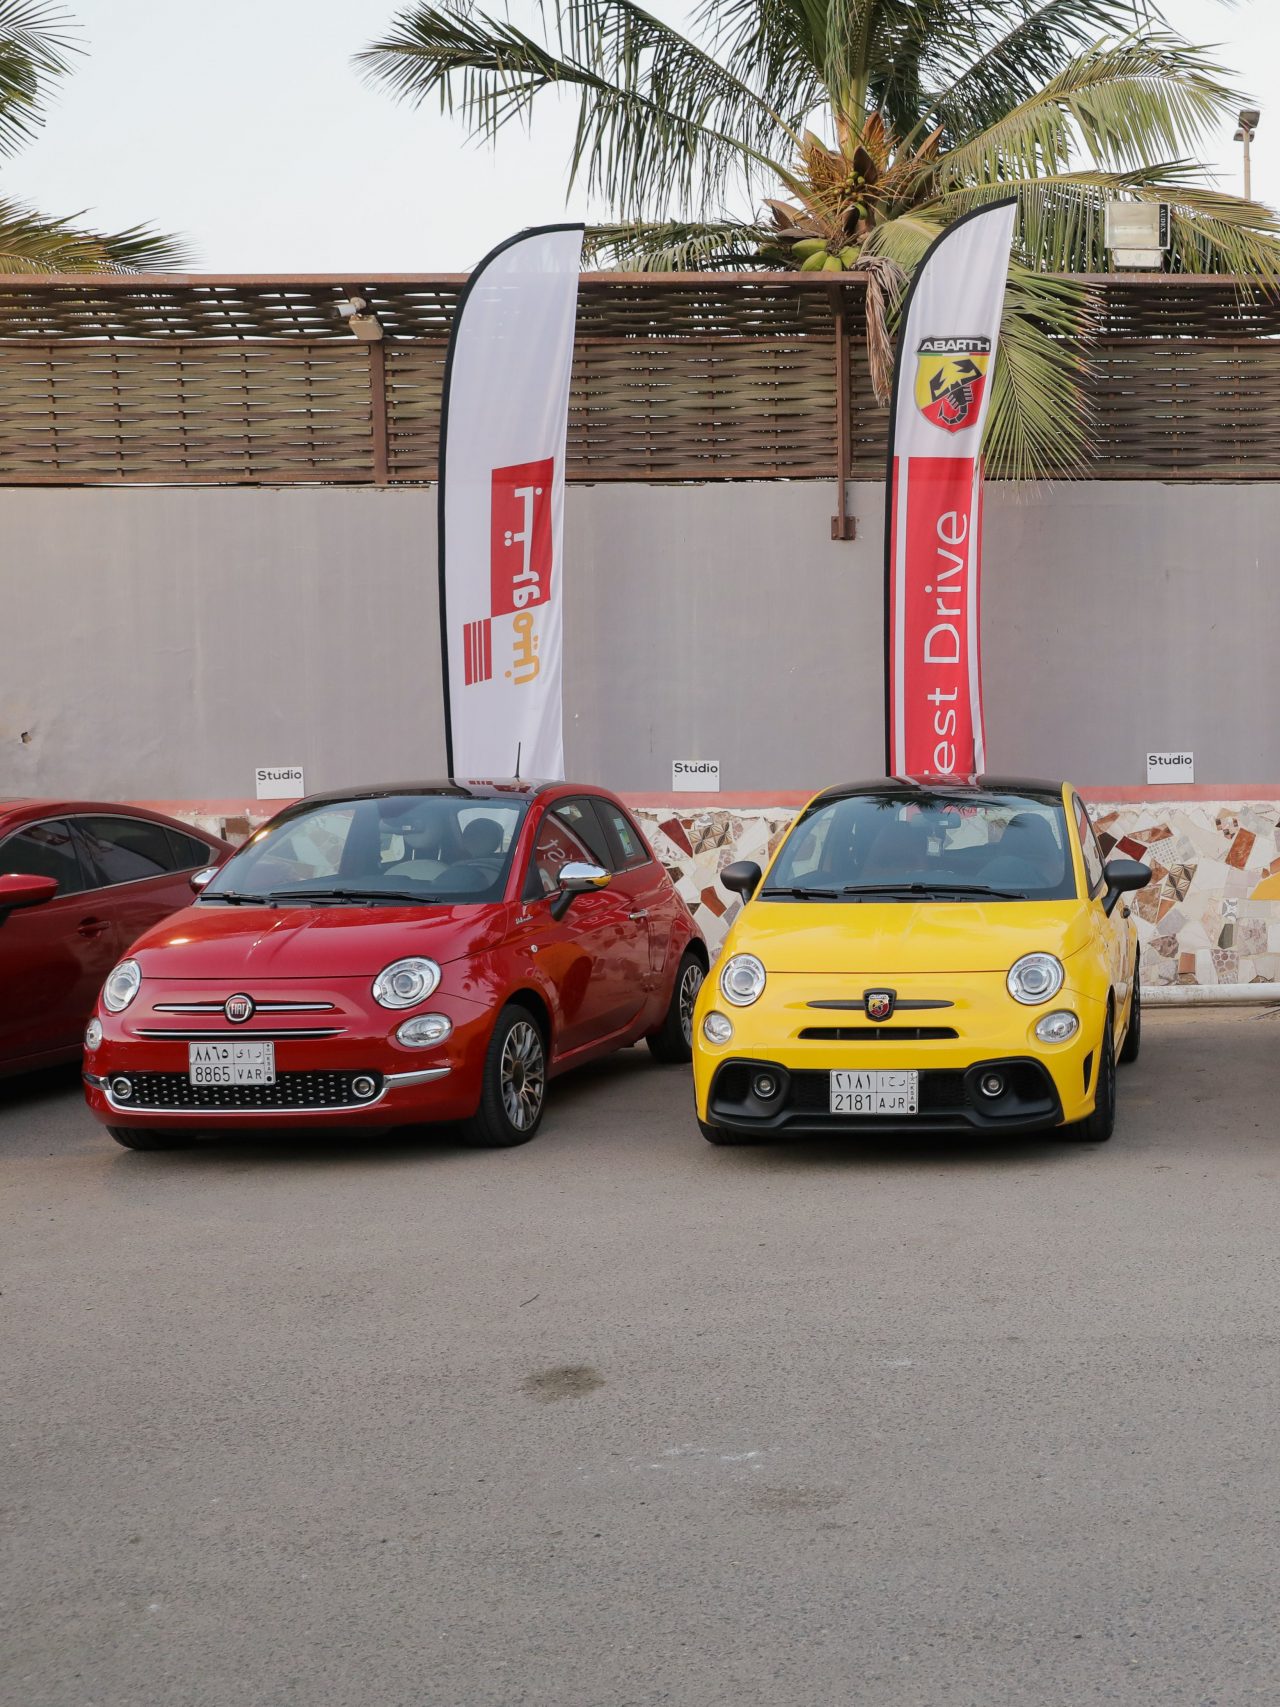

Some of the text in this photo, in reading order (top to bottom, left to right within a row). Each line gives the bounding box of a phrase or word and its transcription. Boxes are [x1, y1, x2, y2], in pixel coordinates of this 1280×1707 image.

[921, 339, 989, 351] ABARTH
[504, 486, 543, 686] بترومين
[923, 510, 967, 774] est Drive
[1148, 755, 1192, 766] Studio
[674, 762, 718, 773] Studio
[257, 769, 302, 781] Studio
[231, 1003, 247, 1015] FIAT
[195, 1066, 262, 1083] 8865 VAR
[835, 1094, 905, 1111] 2181 AJR
